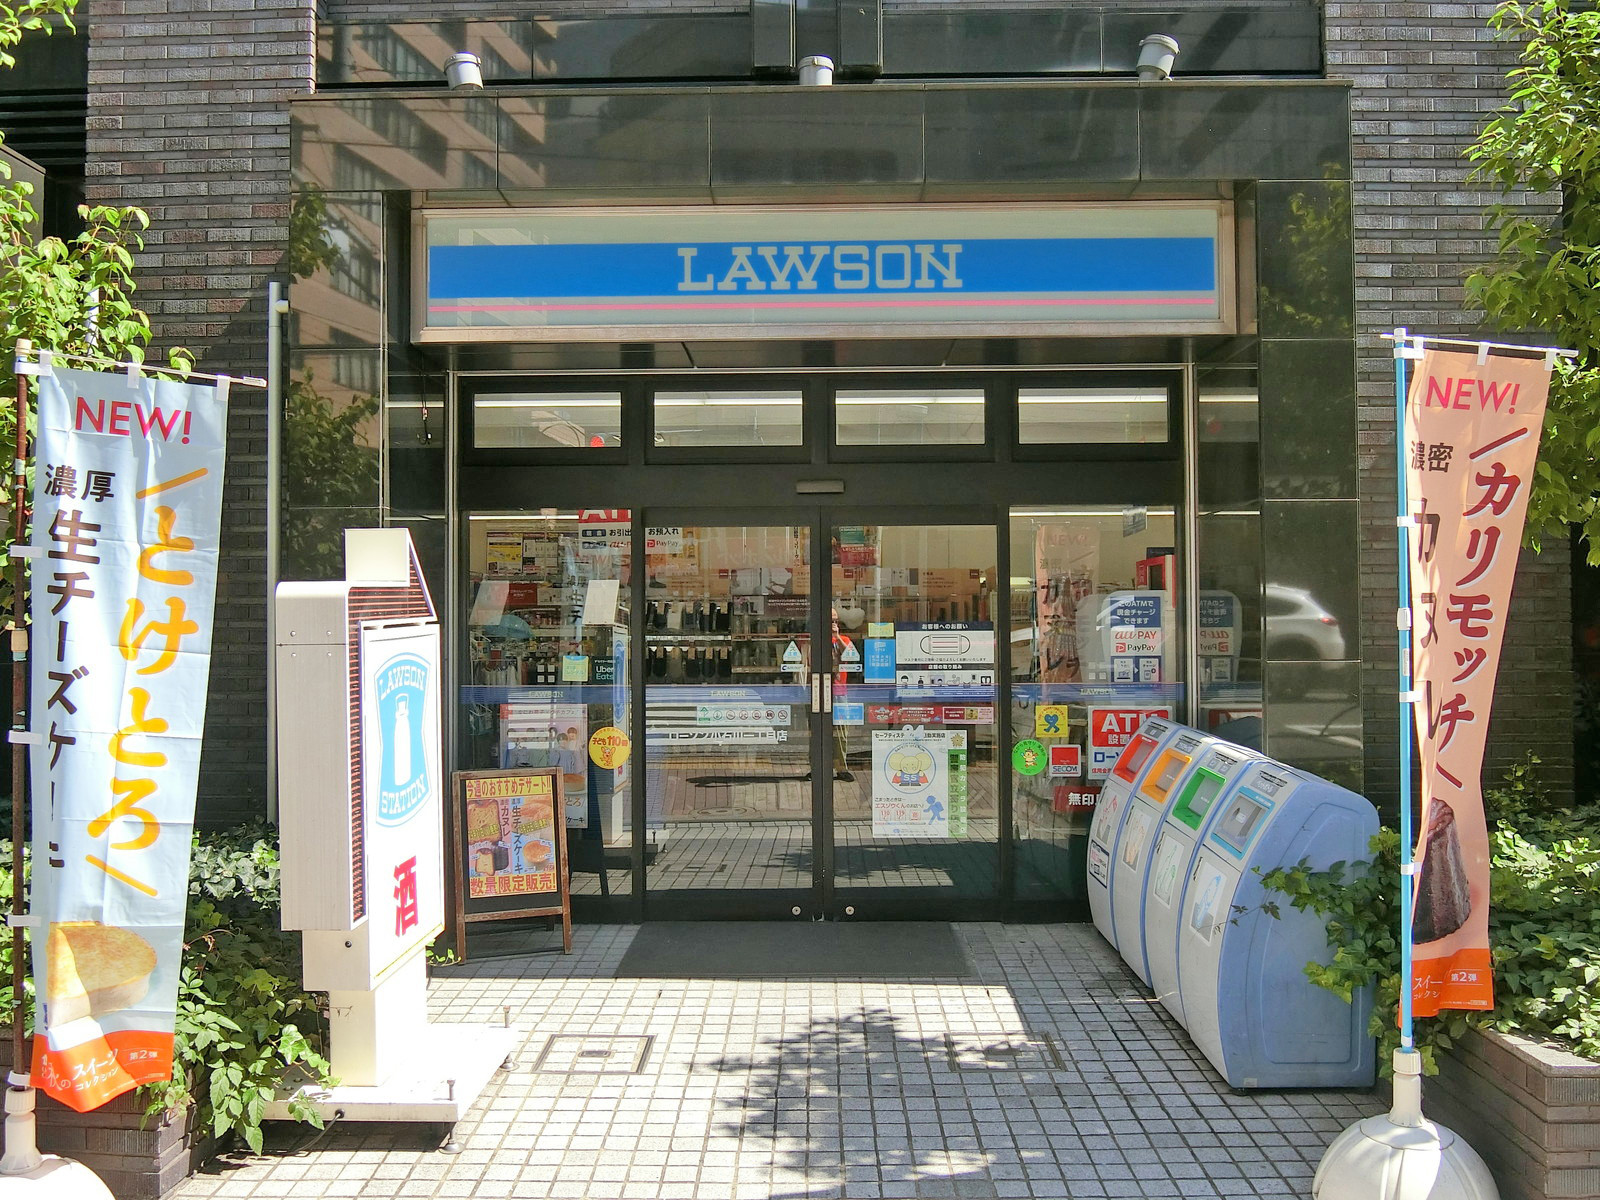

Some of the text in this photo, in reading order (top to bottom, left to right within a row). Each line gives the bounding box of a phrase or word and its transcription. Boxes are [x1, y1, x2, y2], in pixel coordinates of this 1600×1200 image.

[677, 242, 963, 292] LAWSON
[1424, 376, 1520, 415] NEW!
[74, 396, 192, 445] NEW!
[1411, 440, 1453, 473] 濃密
[44, 463, 116, 502] 濃厚
[1127, 643, 1156, 652] PayPay
[1138, 630, 1156, 639] PAY
[379, 664, 426, 700] LAWSON
[596, 665, 613, 673] Uber
[1094, 751, 1119, 762] ロー
[381, 773, 426, 816] STATION
[501, 806, 511, 836] カヌレ
[511, 805, 523, 874] 生チーズケーキ
[393, 854, 419, 937] 酒
[470, 872, 556, 896] 数量限定販売!
[1450, 971, 1477, 983] 第2弾
[129, 1049, 158, 1060] 第2弾
